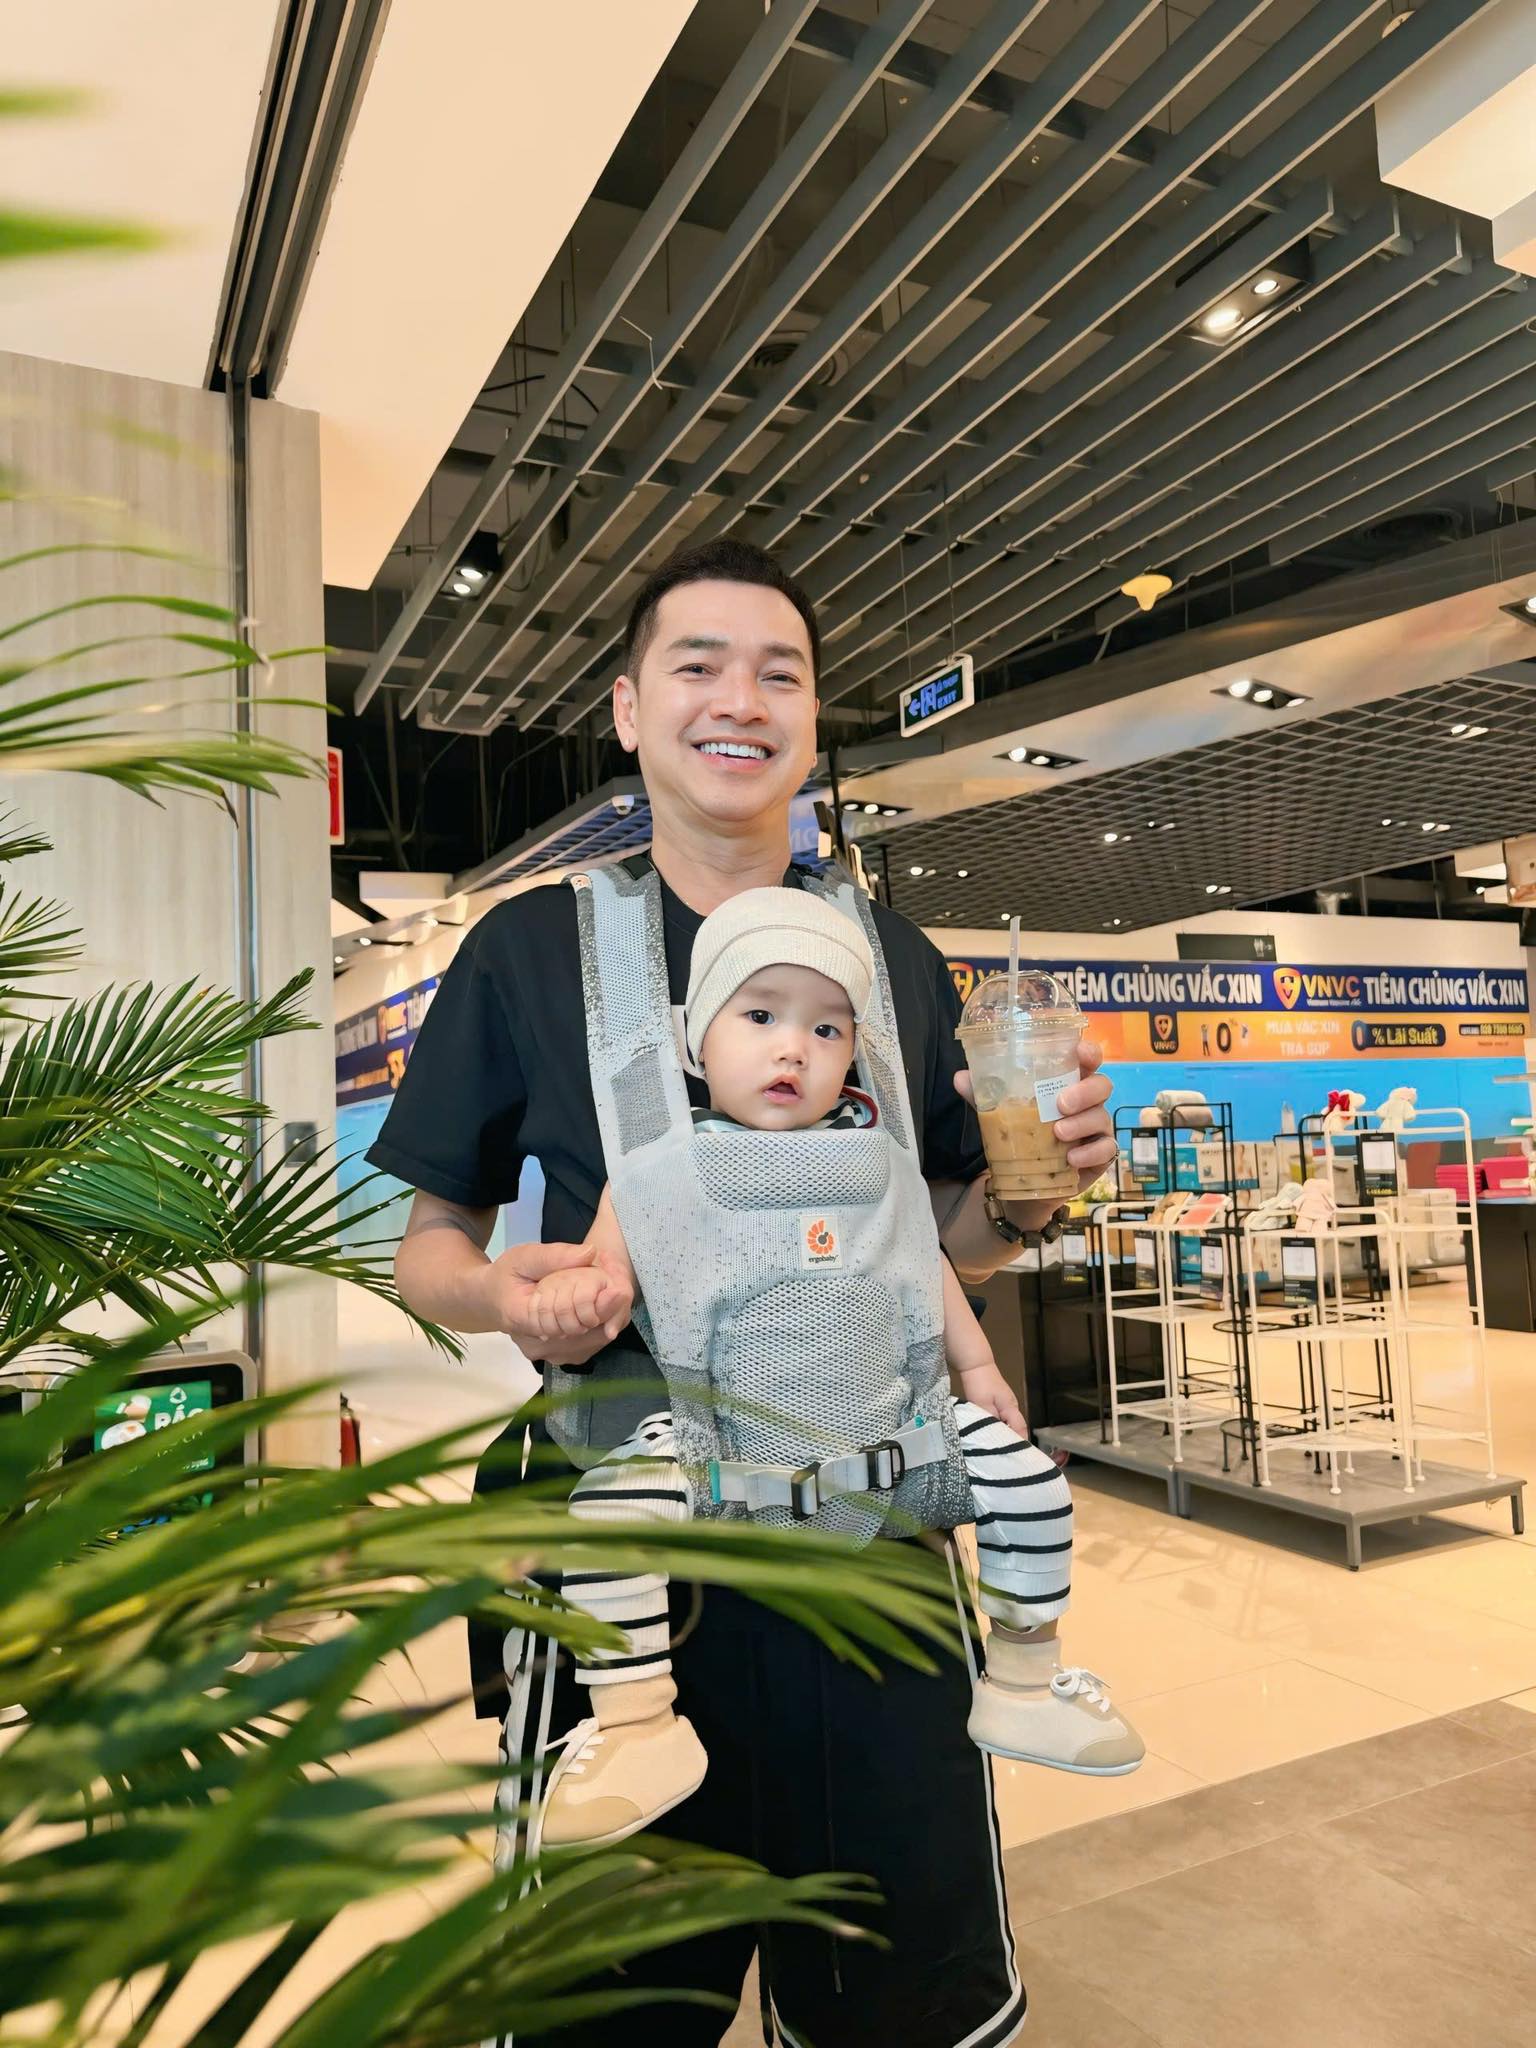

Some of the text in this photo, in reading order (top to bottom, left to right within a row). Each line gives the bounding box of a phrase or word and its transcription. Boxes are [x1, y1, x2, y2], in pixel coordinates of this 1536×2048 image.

[1053, 966, 1109, 1003] TIÊM
[1111, 964, 1185, 1004] CHỦNG
[1226, 974, 1262, 1004] XIN
[1302, 974, 1360, 998] VNVC
[1363, 971, 1407, 1005] TIÊM
[1408, 969, 1466, 1006] CHỦNG
[1499, 979, 1525, 1006] XIN
